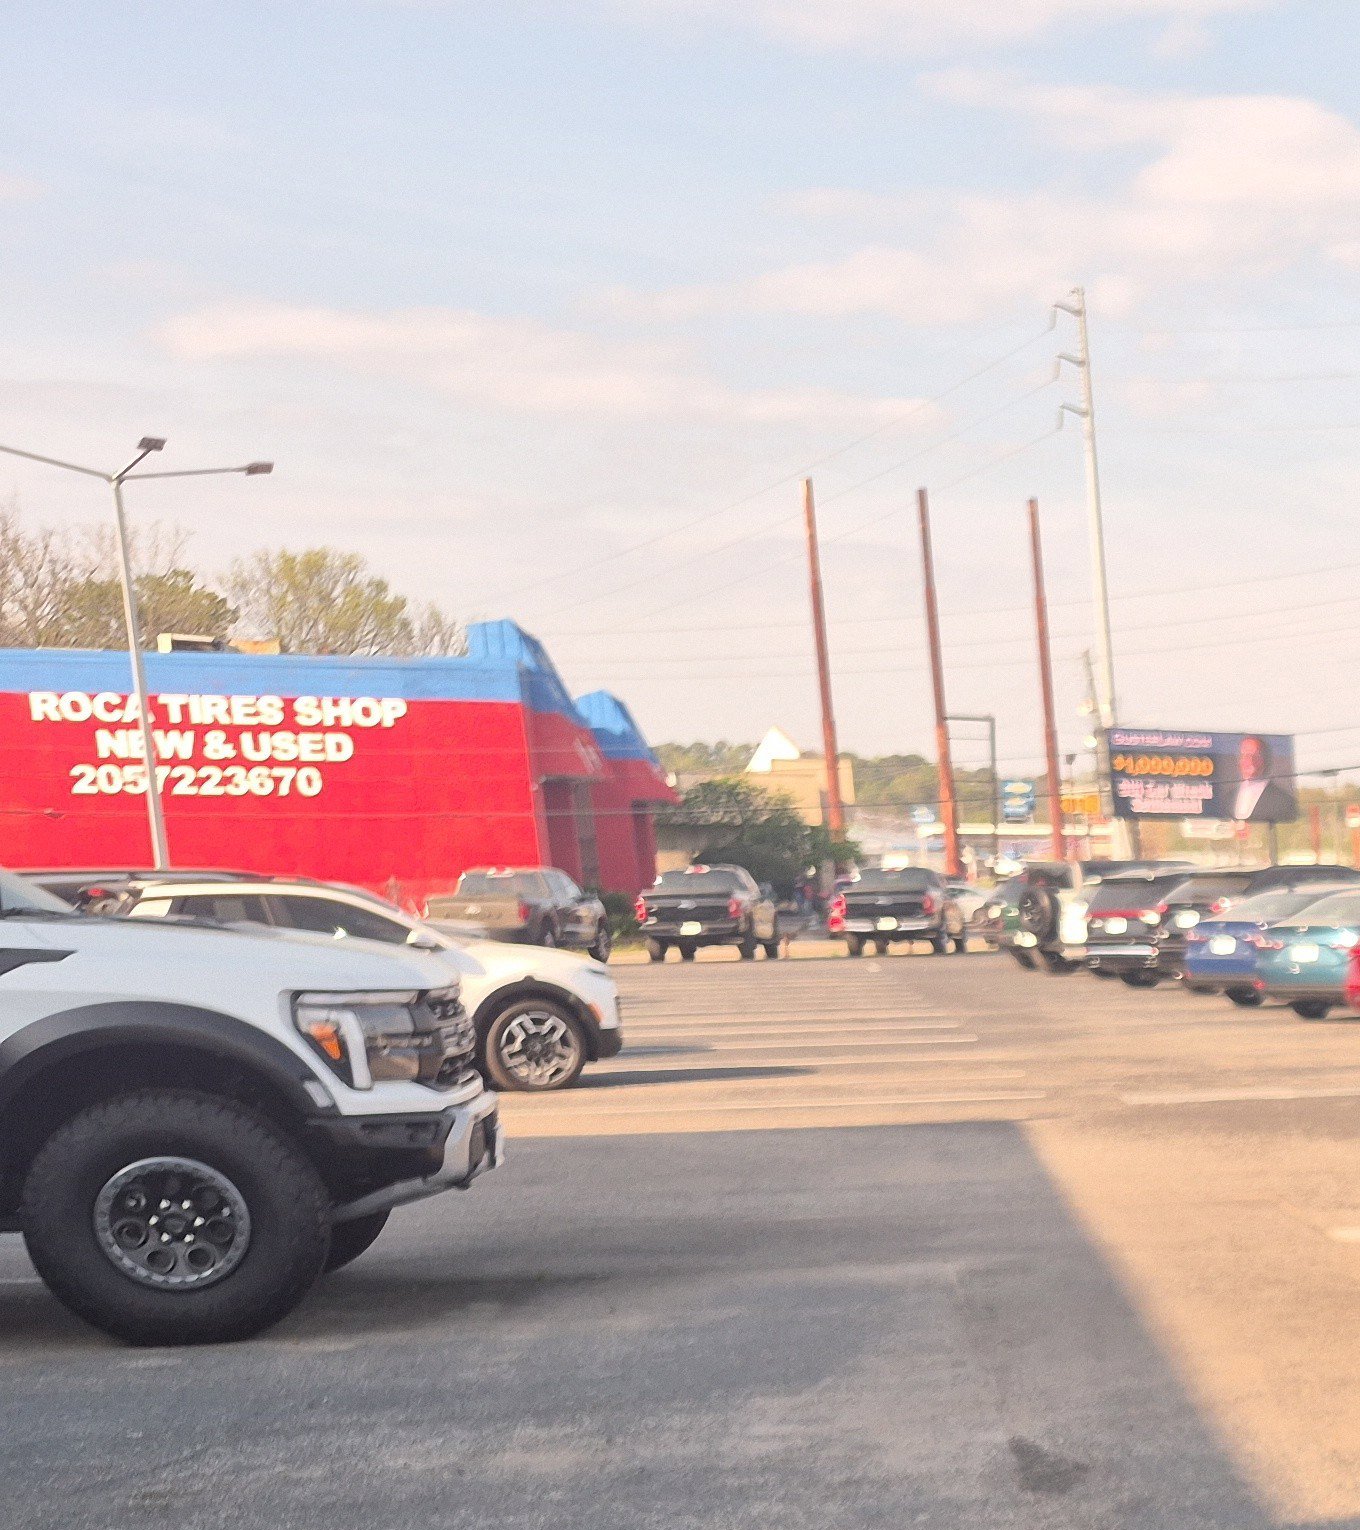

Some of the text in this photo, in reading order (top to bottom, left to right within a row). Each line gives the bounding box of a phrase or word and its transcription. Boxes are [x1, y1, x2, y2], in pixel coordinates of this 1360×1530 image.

[158, 694, 285, 726] TIRES
[294, 696, 408, 728] SHOP
[203, 730, 237, 760] &
[241, 731, 354, 763] USED
[69, 764, 323, 797] 2057223670
